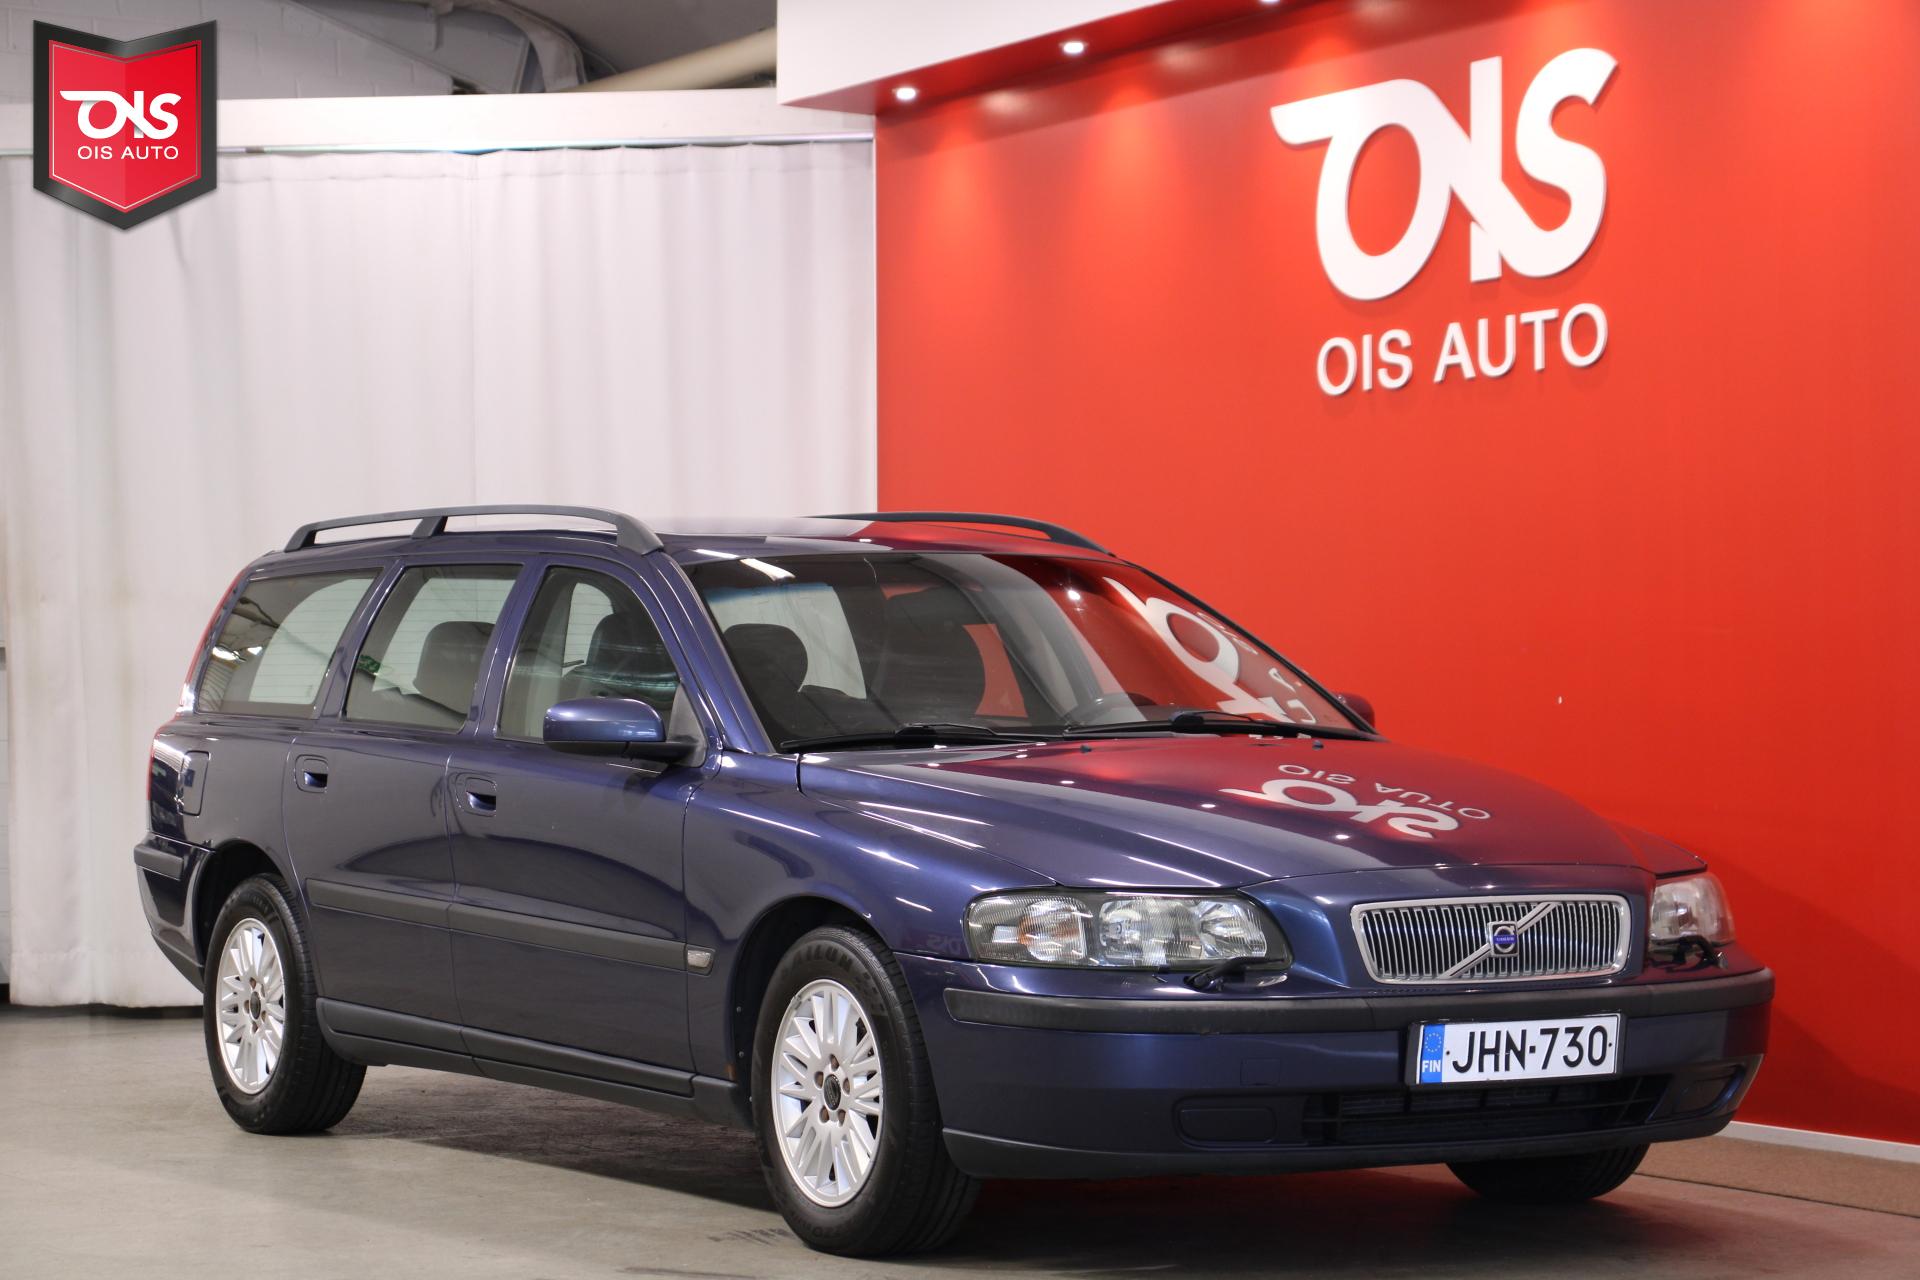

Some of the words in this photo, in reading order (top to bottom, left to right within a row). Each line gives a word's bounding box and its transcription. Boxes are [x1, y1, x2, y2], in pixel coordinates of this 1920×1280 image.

[1270, 47, 1618, 301] OIS
[1316, 328, 1413, 396] OIS
[1433, 302, 1608, 384] AUTO
[1421, 1059, 1441, 1073] FIN
[1452, 1025, 1608, 1074] JHN-730
